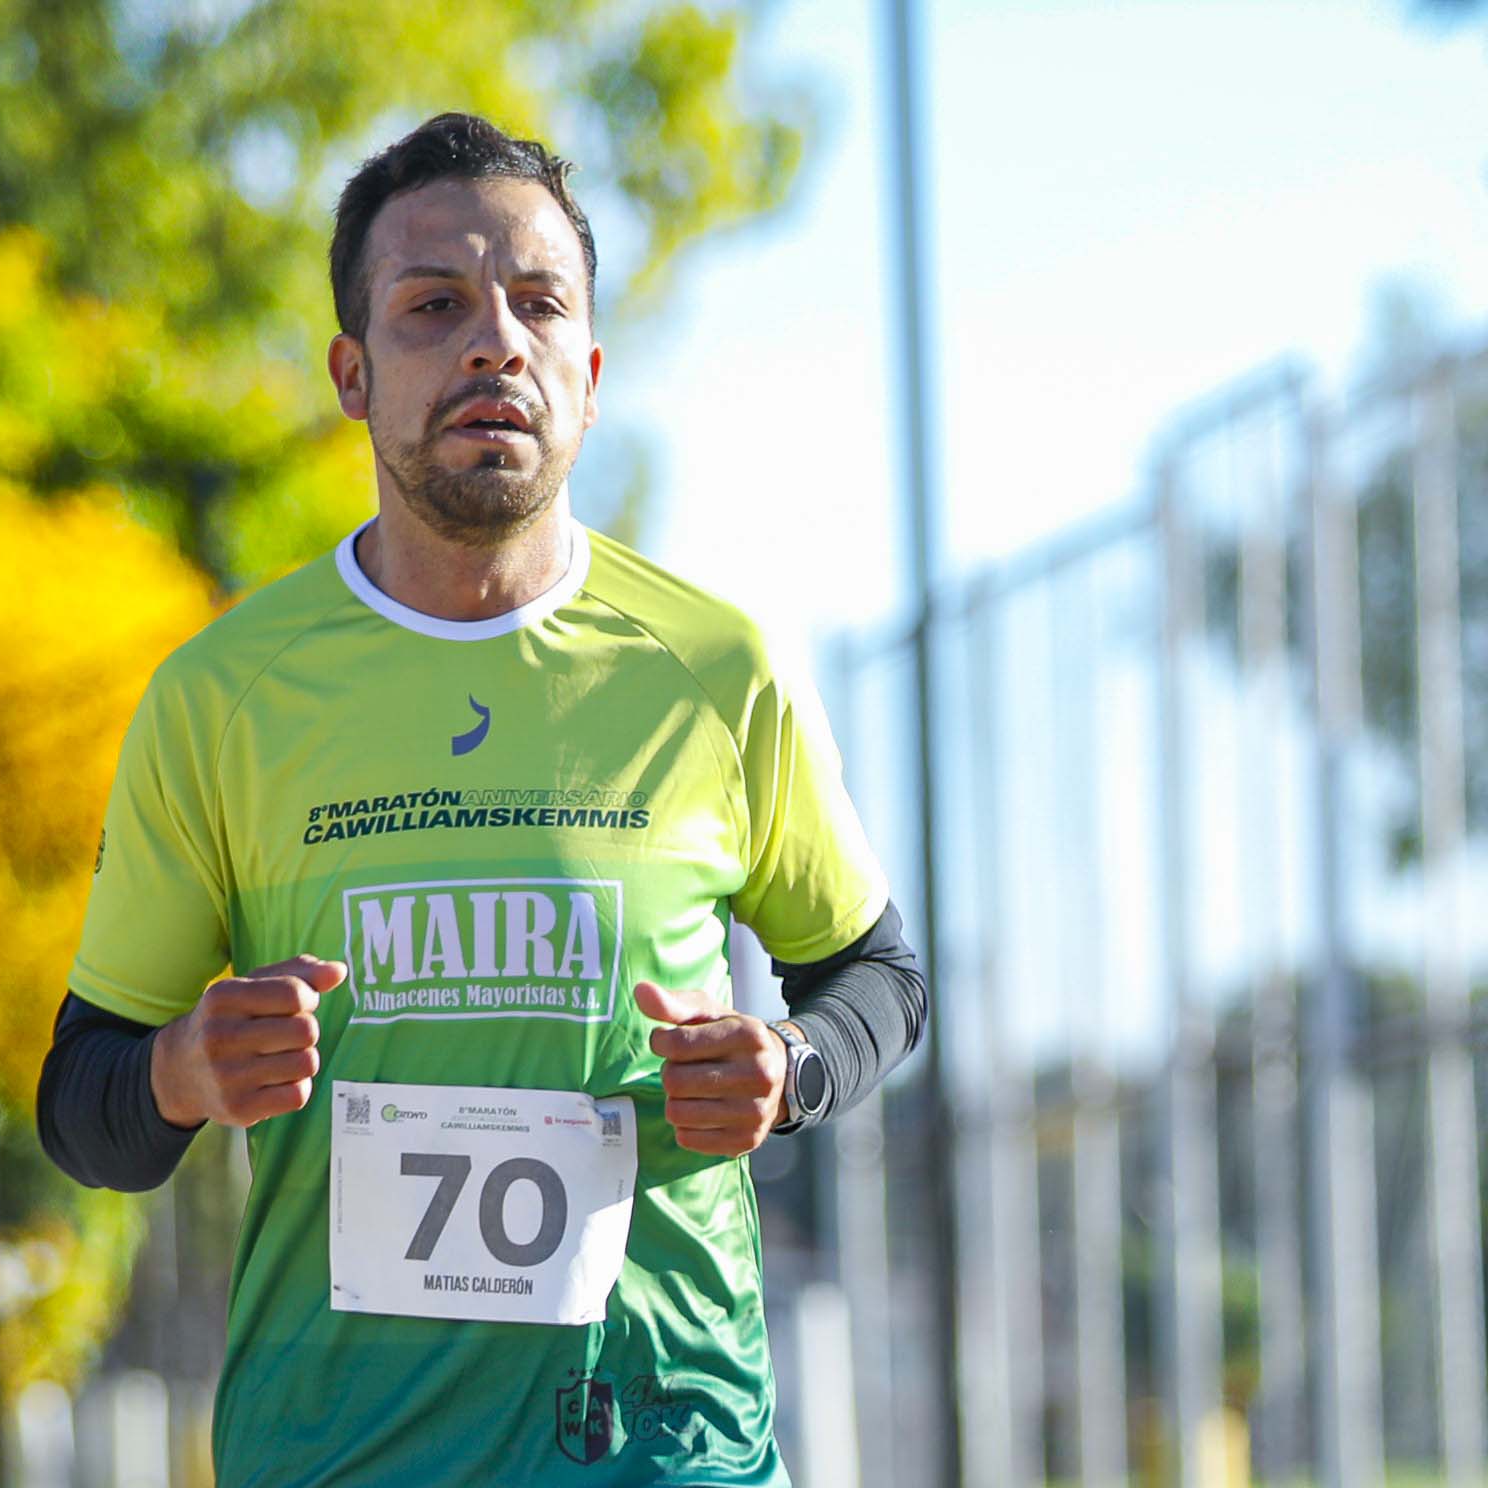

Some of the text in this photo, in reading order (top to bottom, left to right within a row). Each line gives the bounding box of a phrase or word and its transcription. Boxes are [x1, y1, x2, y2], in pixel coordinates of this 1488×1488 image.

[303, 807, 651, 845] CAWILLIAMSKEMMIS
[358, 890, 603, 985] MAIRA
[363, 983, 601, 1011] Almacenes Mayoristas S.A.
[399, 1151, 569, 1268] 70
[423, 1274, 533, 1295] MATIAS CALDERÓN
